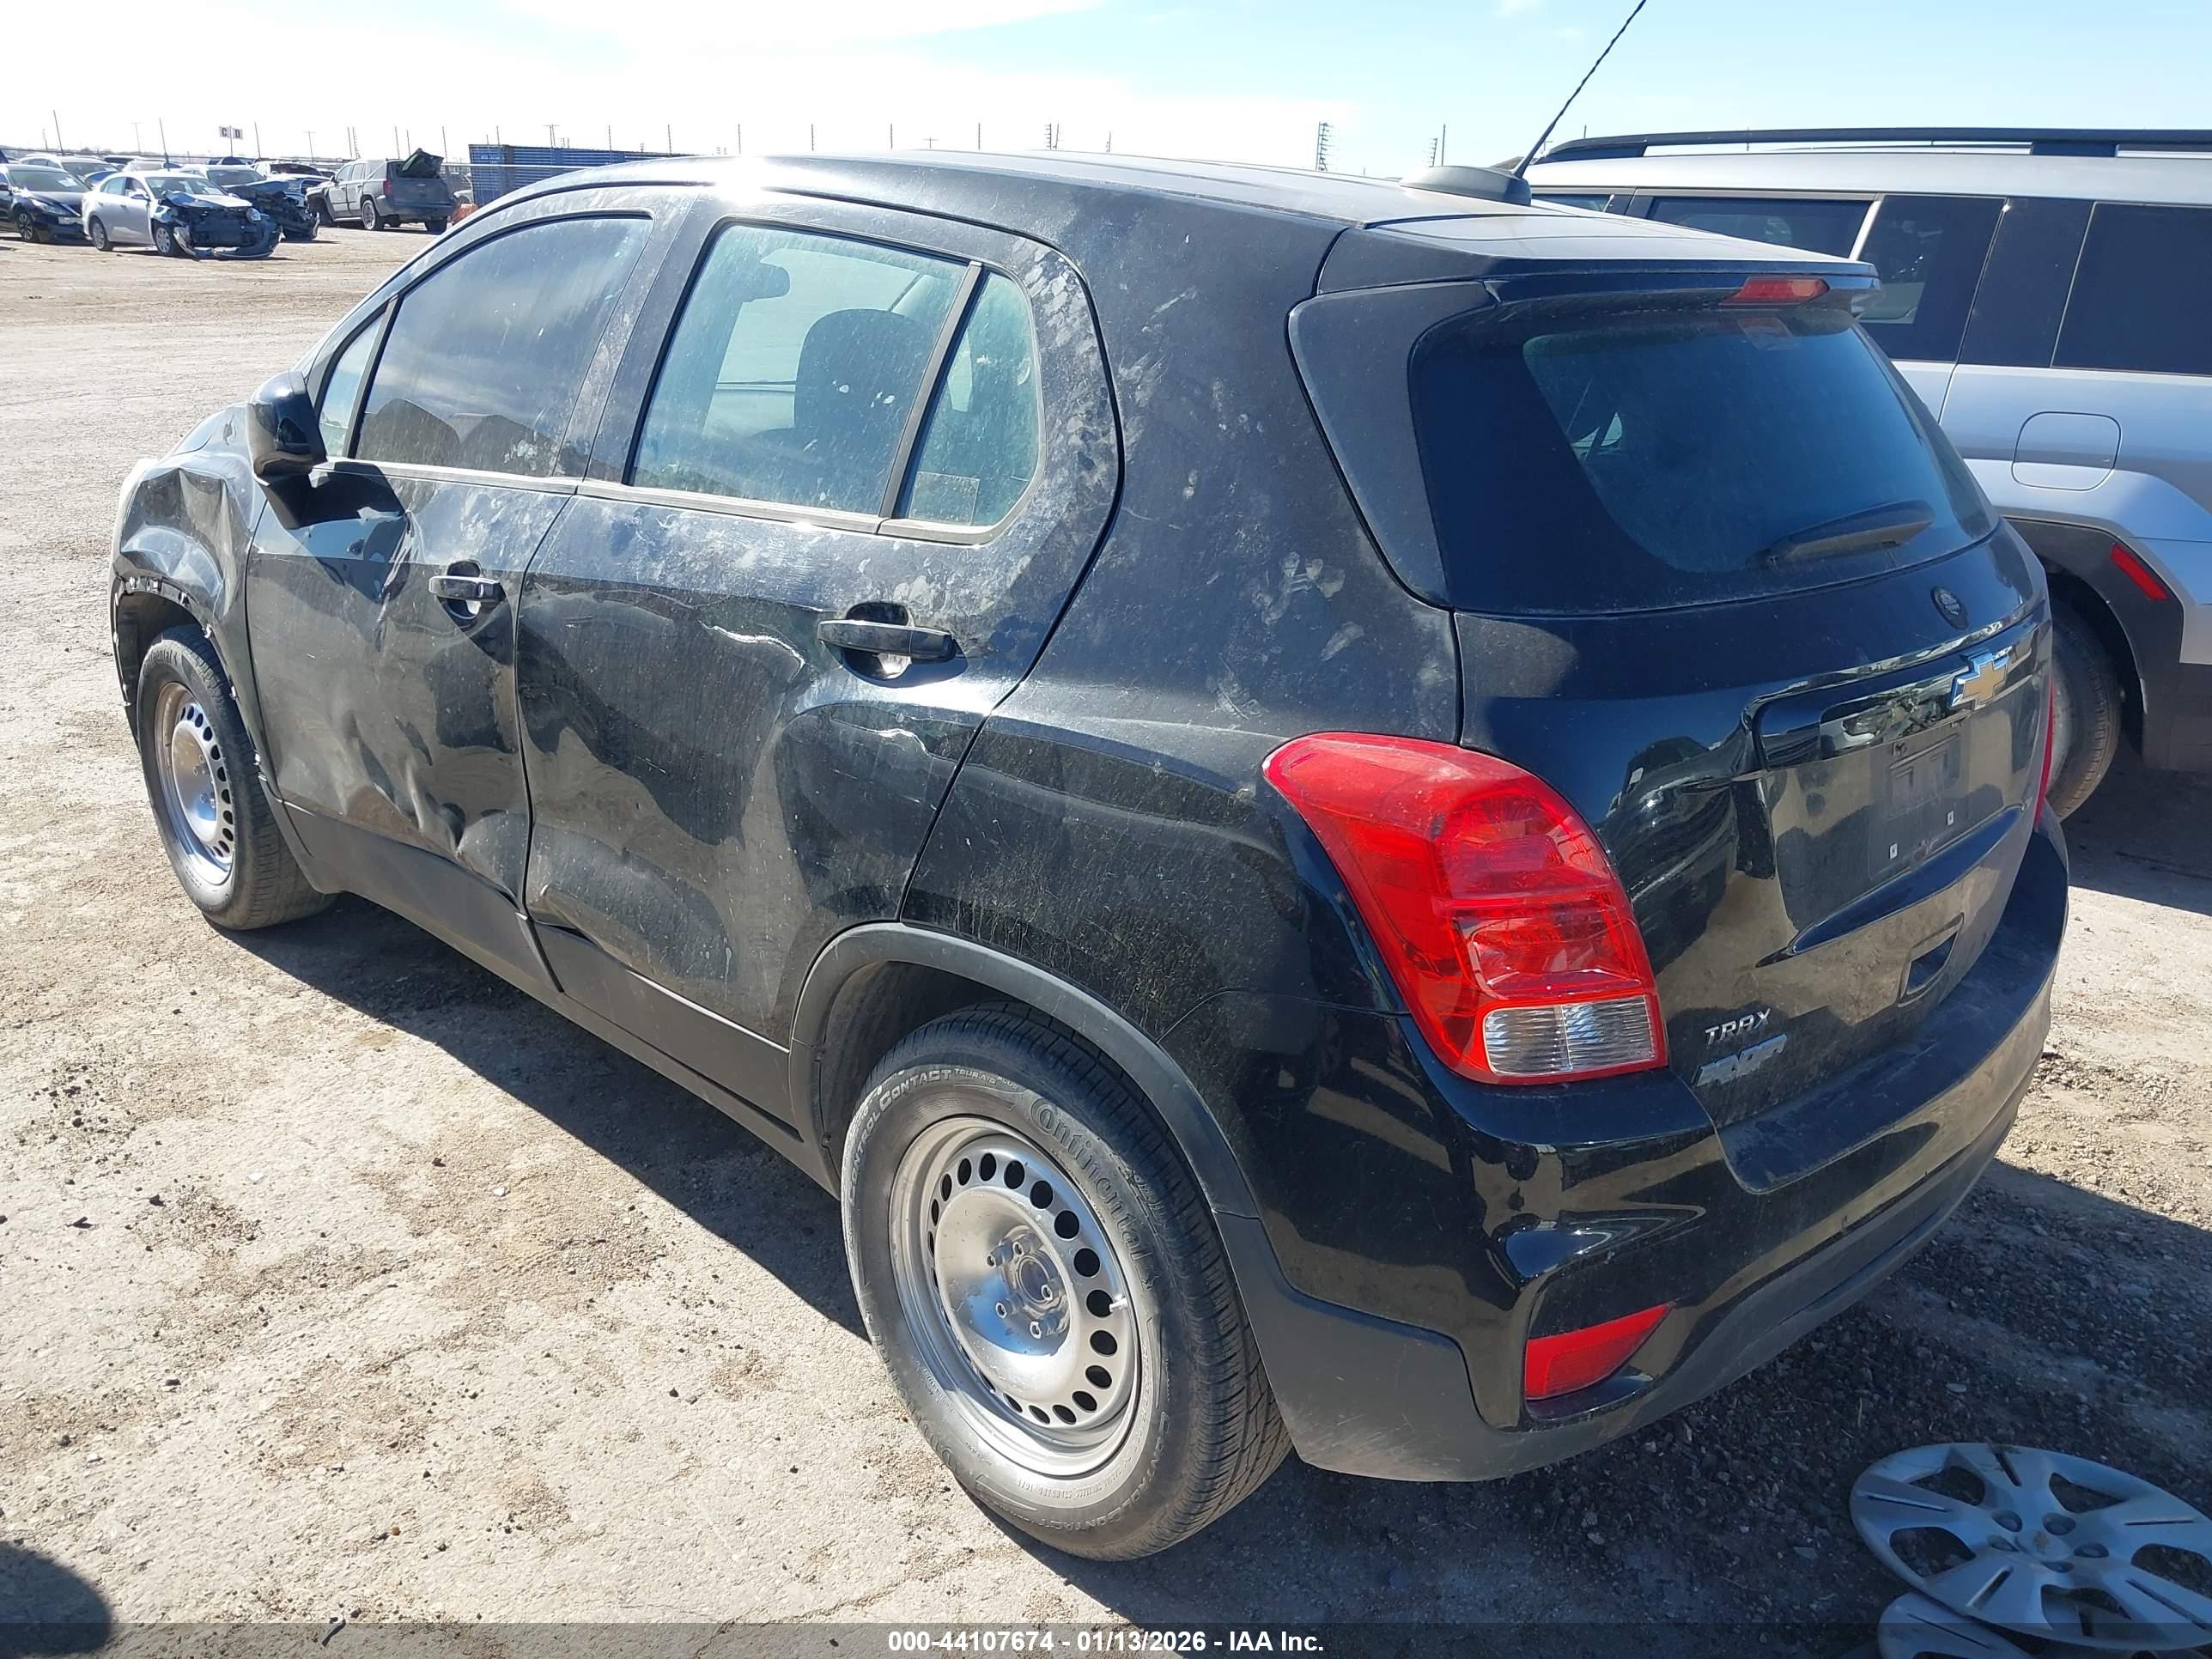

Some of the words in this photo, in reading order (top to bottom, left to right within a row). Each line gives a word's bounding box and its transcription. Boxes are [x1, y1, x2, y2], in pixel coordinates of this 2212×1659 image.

[222, 127, 228, 137] C
[234, 129, 240, 138] D
[1705, 1008, 1771, 1045] TRAX
[1030, 1097, 1153, 1262] Continental
